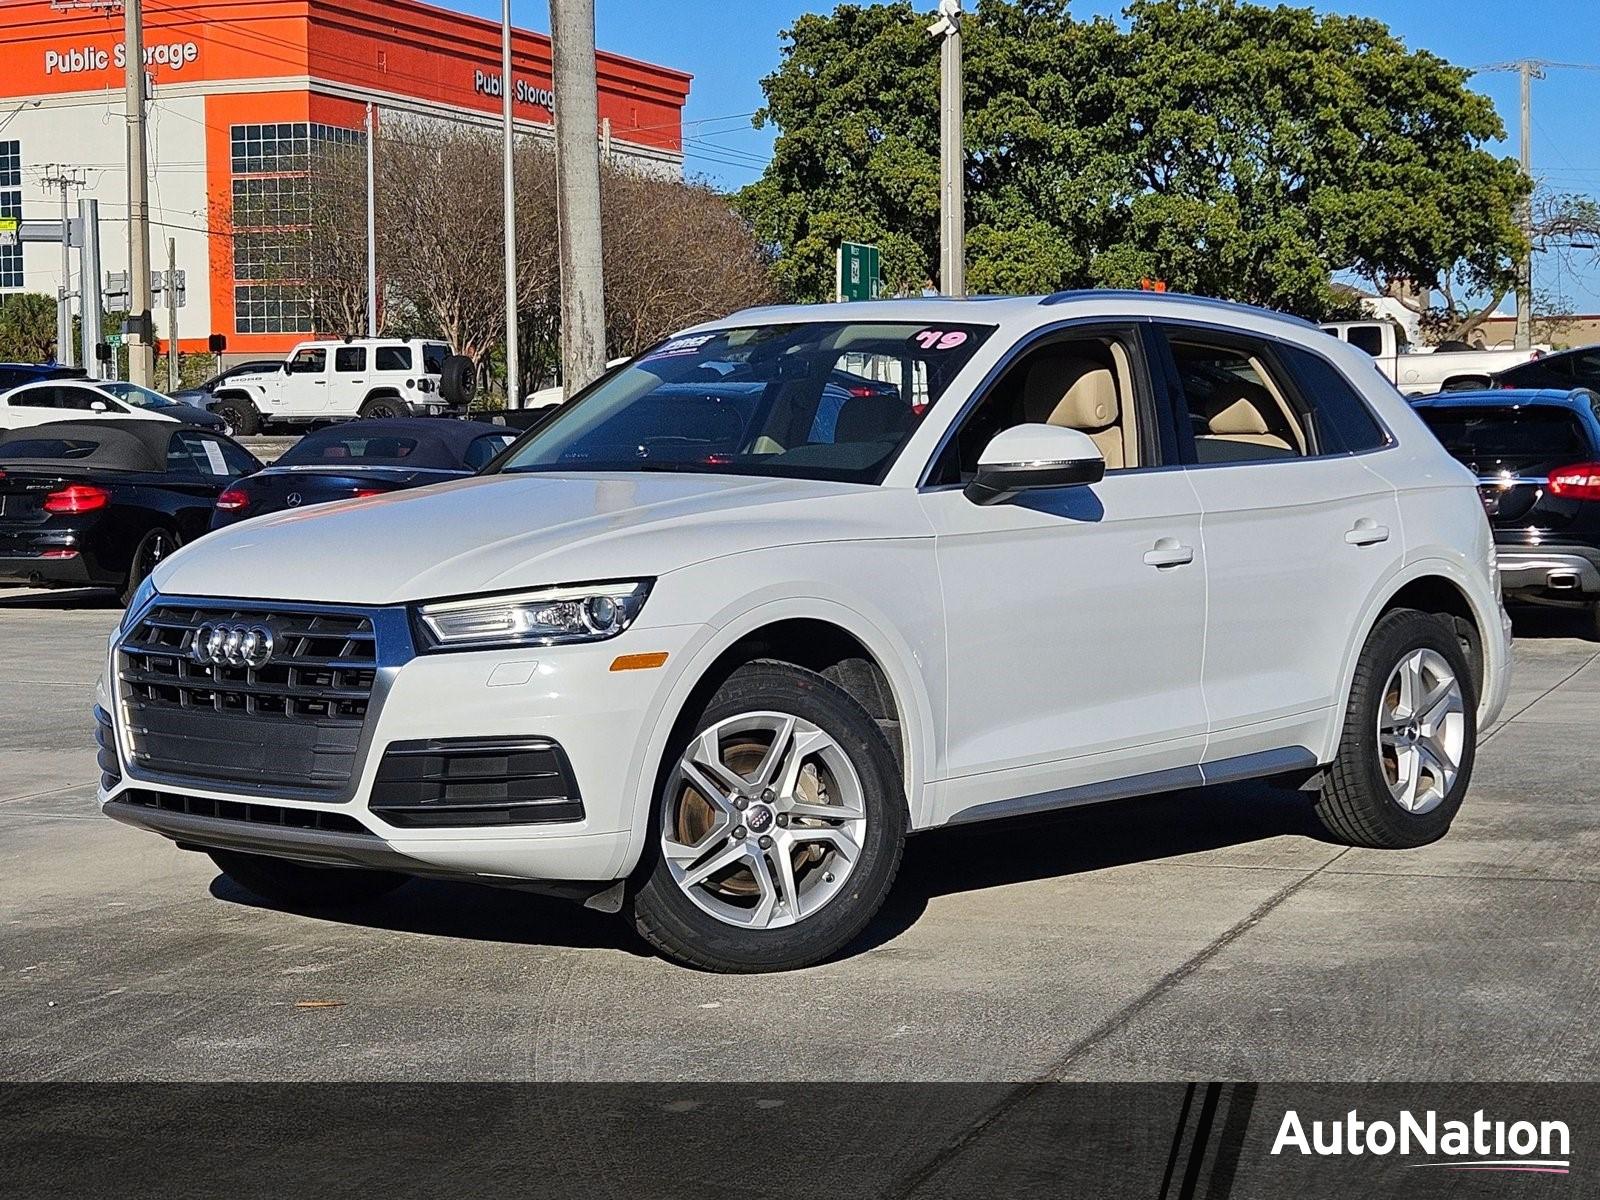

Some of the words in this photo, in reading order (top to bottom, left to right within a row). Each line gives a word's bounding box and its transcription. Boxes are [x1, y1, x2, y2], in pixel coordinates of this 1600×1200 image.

[45, 46, 108, 74] Public
[113, 41, 198, 70] Srage
[475, 69, 514, 97] Publ
[516, 79, 555, 112] Storag
[915, 331, 968, 350] 19
